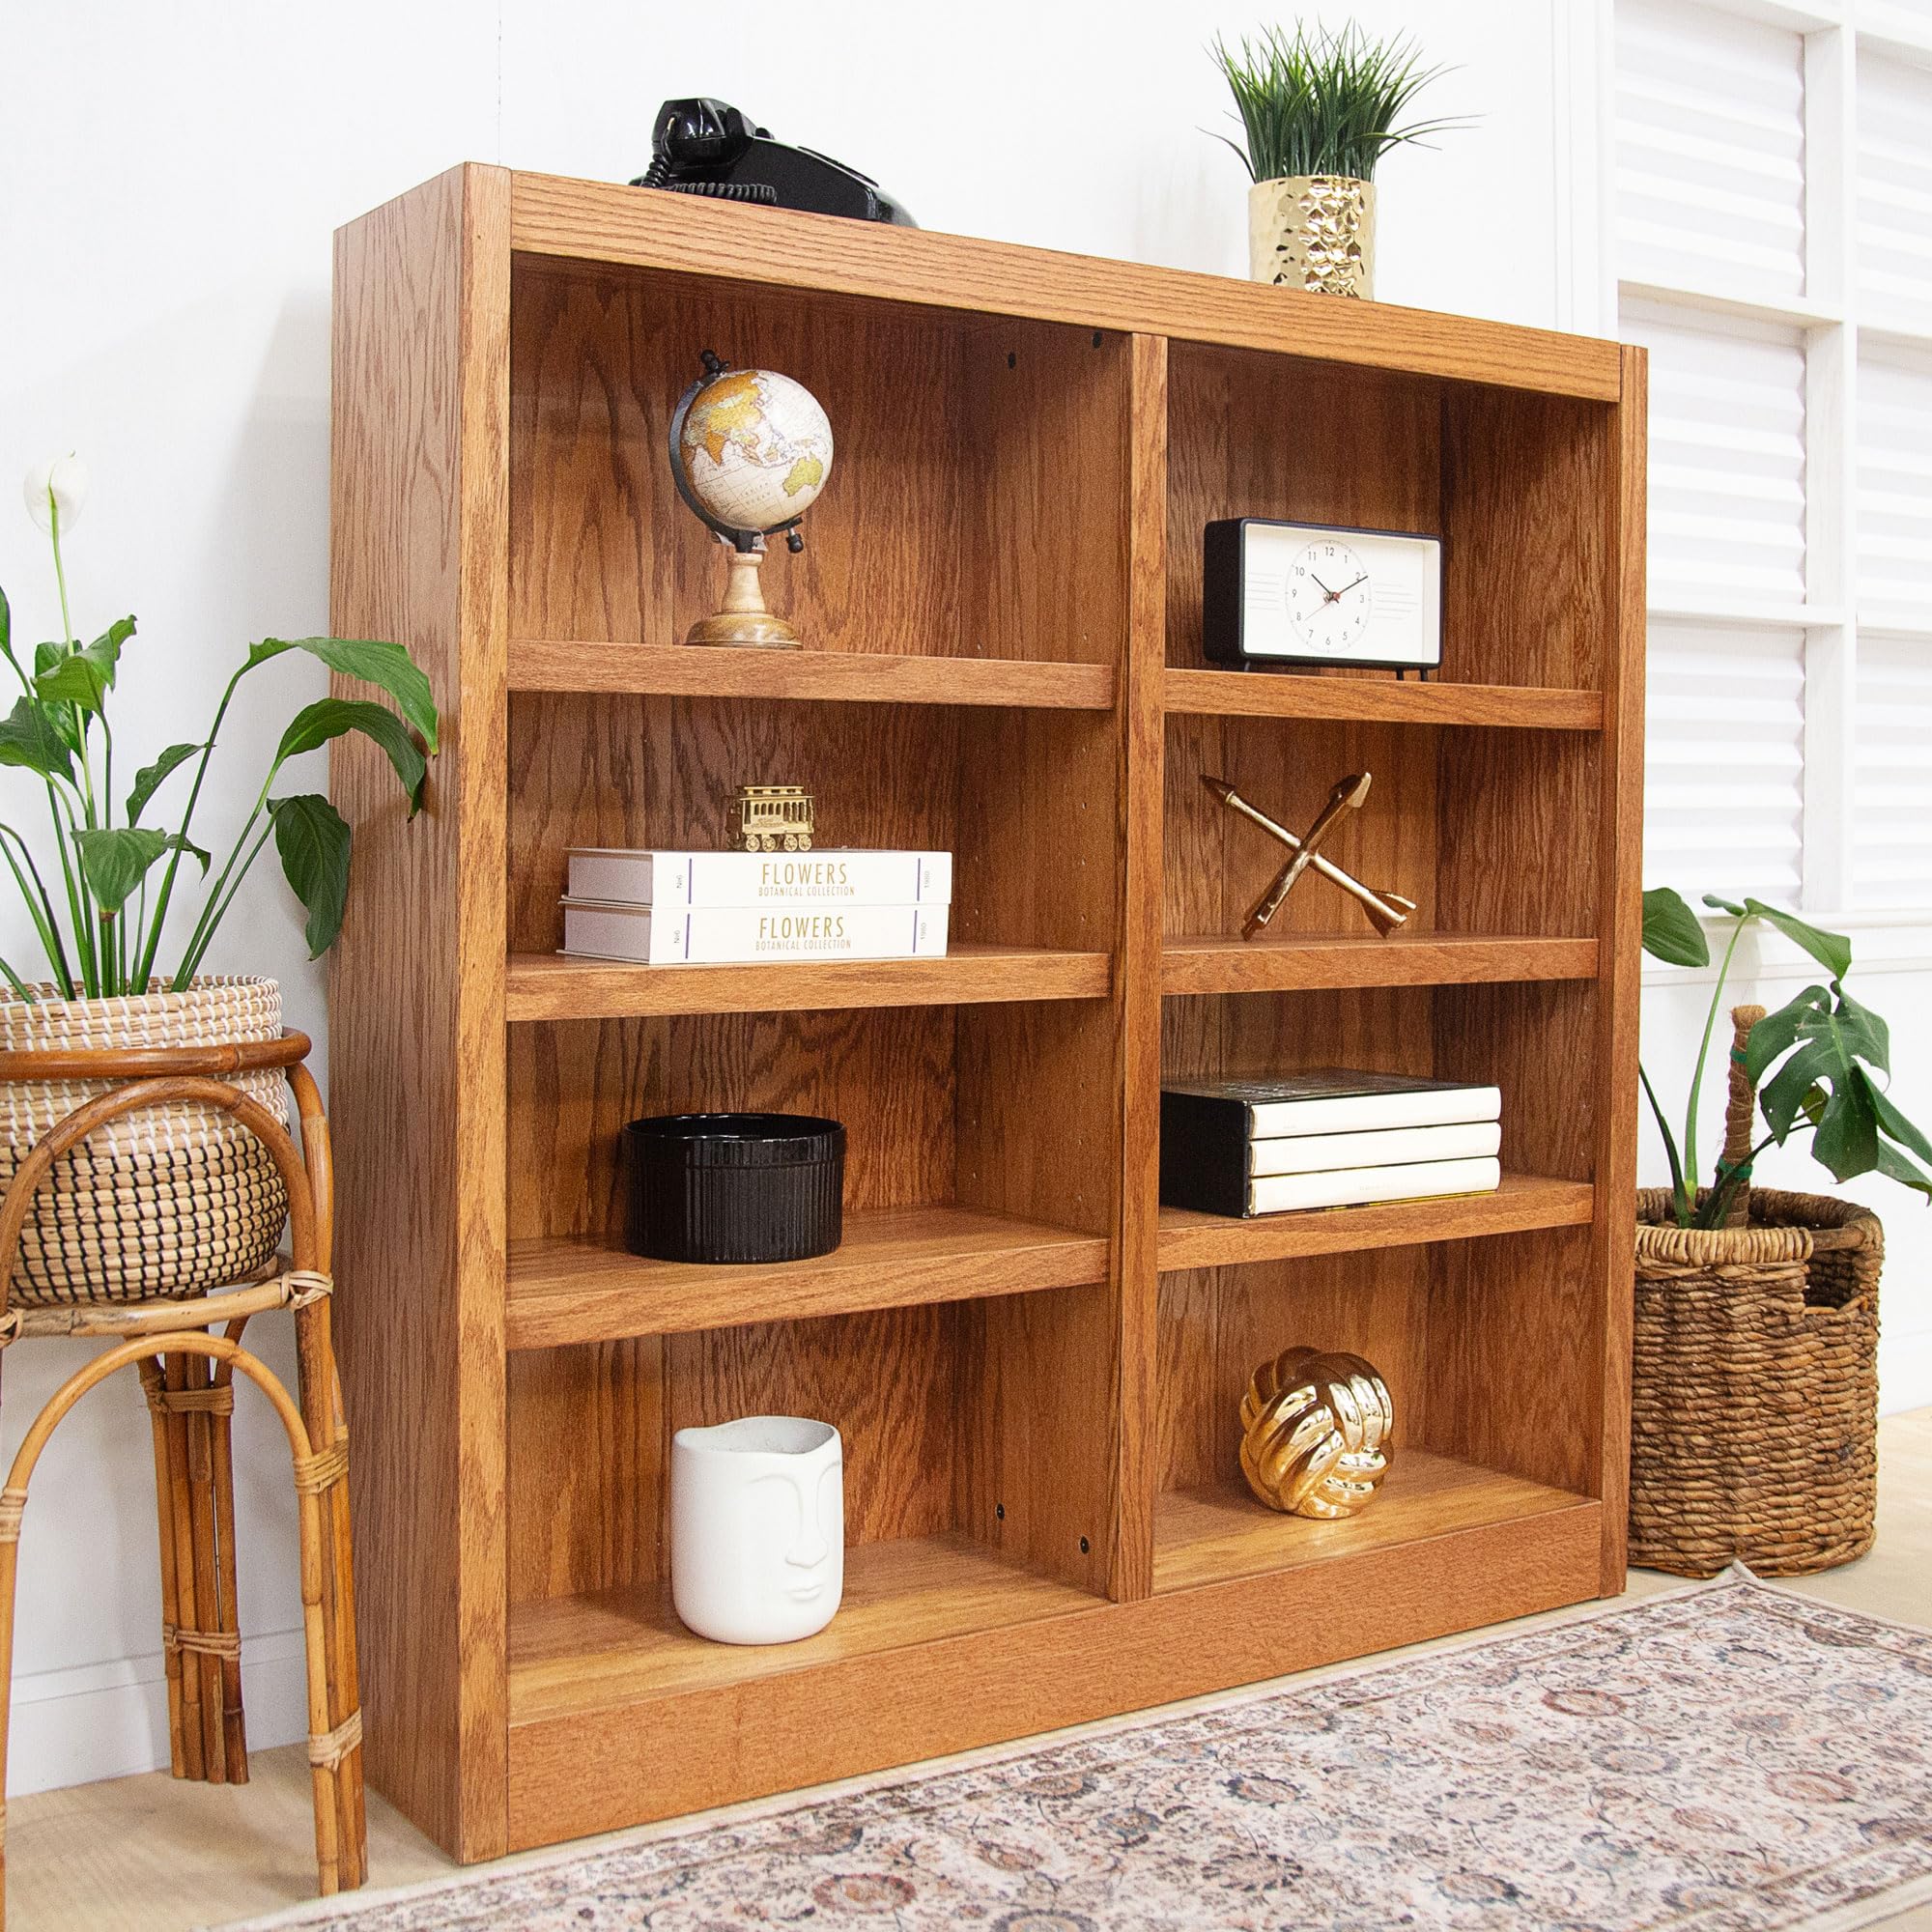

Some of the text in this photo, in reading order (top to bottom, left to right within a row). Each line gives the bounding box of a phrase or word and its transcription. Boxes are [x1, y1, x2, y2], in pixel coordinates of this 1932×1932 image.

[1307, 551, 1318, 561] 11
[1324, 546, 1335, 557] 12
[1294, 566, 1306, 577] 10
[1292, 588, 1297, 599] 9
[1359, 594, 1365, 604] 3
[1295, 611, 1302, 621] 8
[1354, 615, 1360, 625] 4
[1308, 629, 1315, 639] 7
[1342, 631, 1349, 640] 5
[1324, 636, 1331, 646] 6
[761, 863, 847, 885] FLOWERS
[757, 886, 855, 896] BOTANICAL COLLECTION
[759, 916, 844, 939] FLOWERS
[755, 939, 852, 951] BOTANICAL COLLECTION
